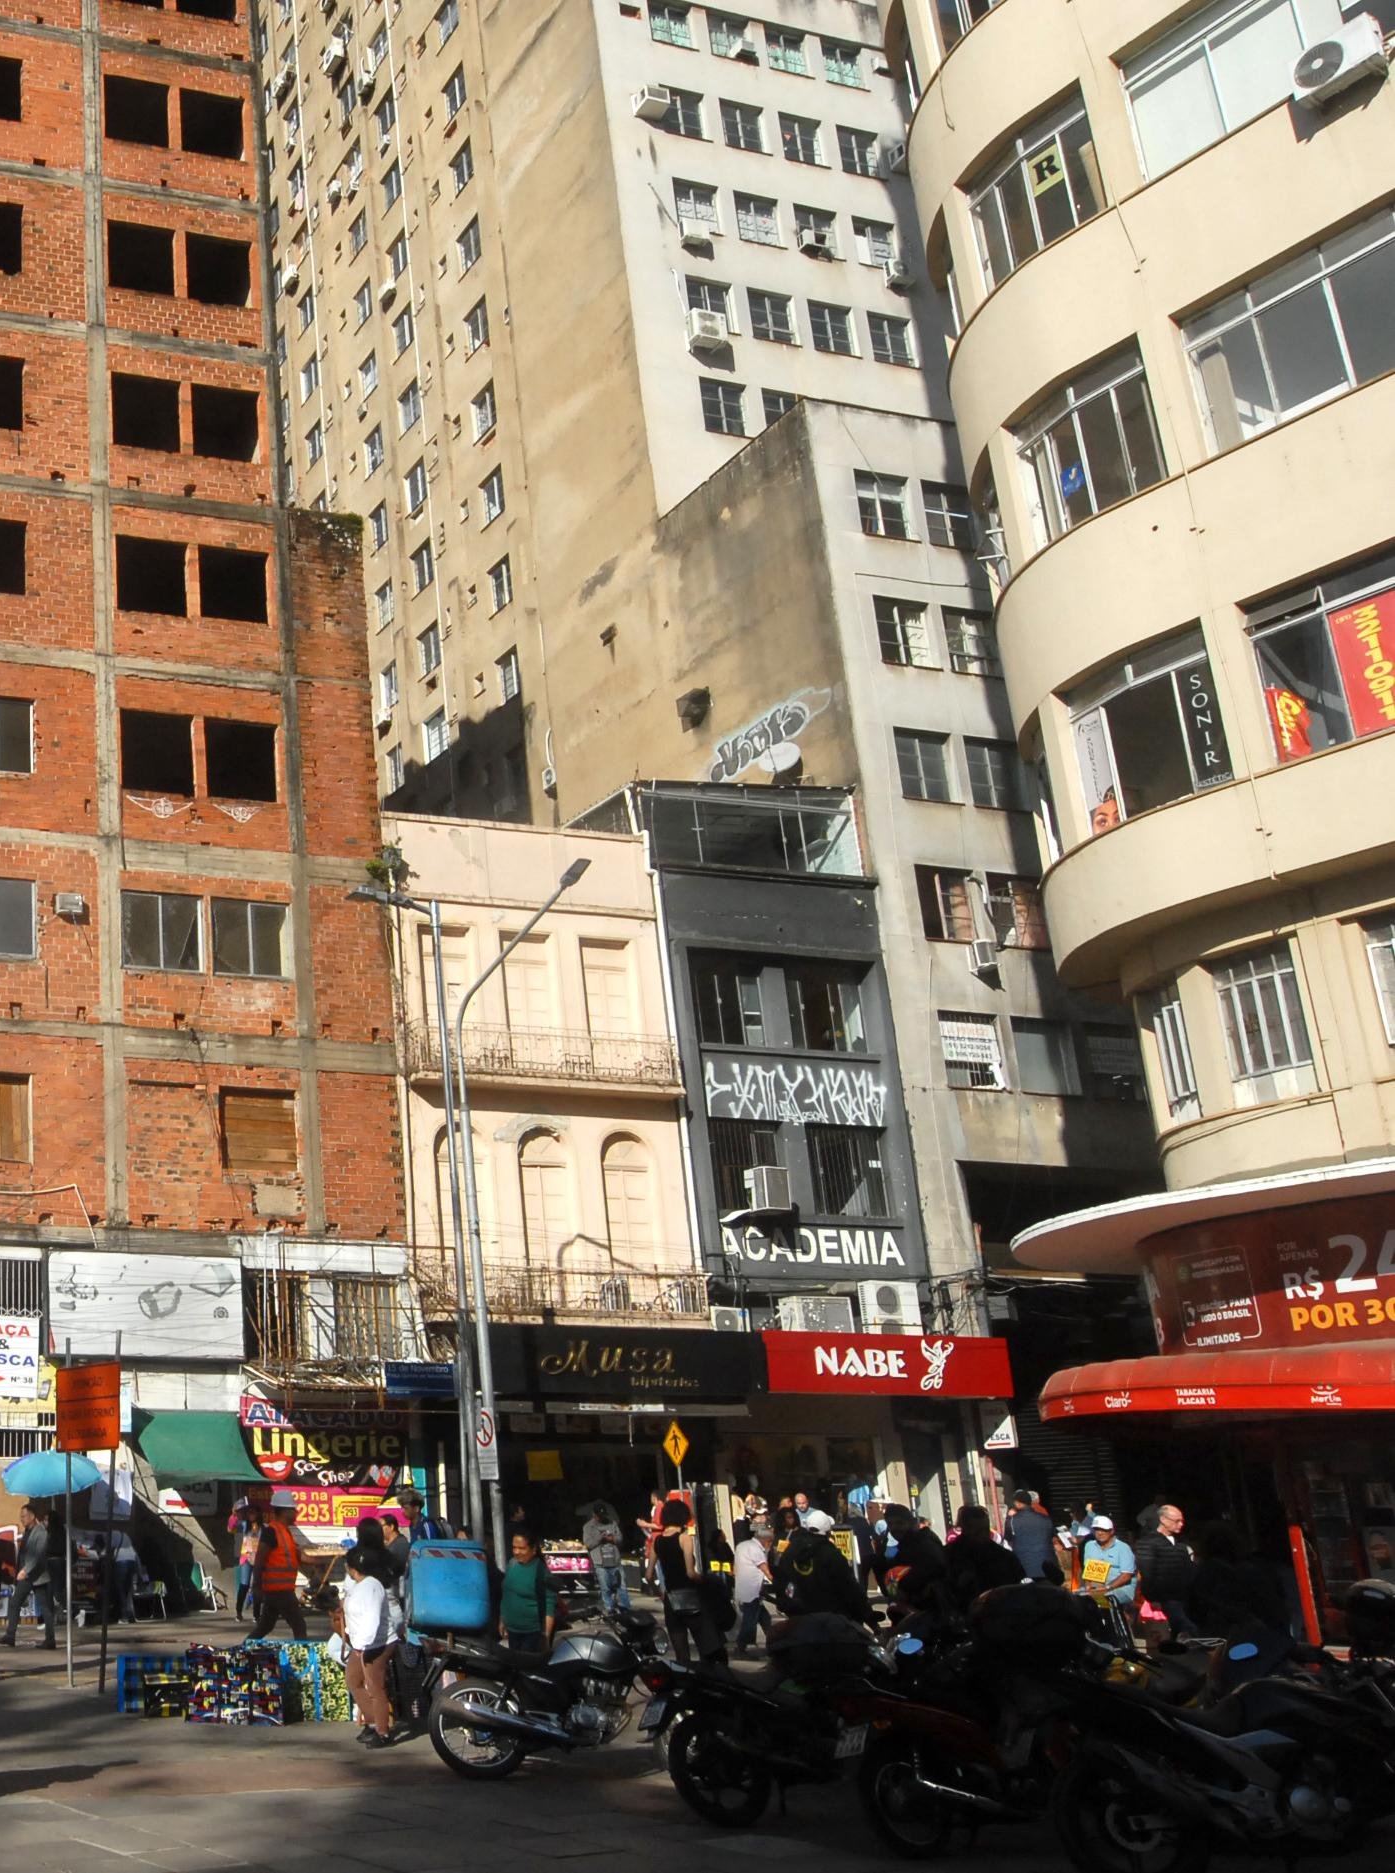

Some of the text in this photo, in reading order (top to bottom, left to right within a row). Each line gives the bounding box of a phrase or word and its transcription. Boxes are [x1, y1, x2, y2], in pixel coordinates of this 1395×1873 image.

[1033, 153, 1060, 187] R
[1189, 673, 1221, 767] SONIR
[721, 1225, 905, 1266] ACADEMIA
[1283, 1266, 1325, 1301] R$
[1229, 1297, 1253, 1308] PARA
[1223, 1308, 1253, 1320] BRASIL
[1288, 1301, 1360, 1333] POR
[1197, 1332, 1242, 1347] ILIMITADOS
[541, 1339, 676, 1378] Musa
[814, 1346, 908, 1378] NABE
[411, 1364, 449, 1373] Novembro
[22, 1376, 34, 1384] 38
[1104, 1393, 1130, 1409] Claro
[1175, 1388, 1216, 1397] TABACARIA
[1177, 1396, 1206, 1405] PLACAR
[253, 1427, 401, 1464] Lingerie
[317, 1468, 355, 1487] Shop
[311, 1491, 329, 1501] na
[295, 1503, 331, 1523] 293
